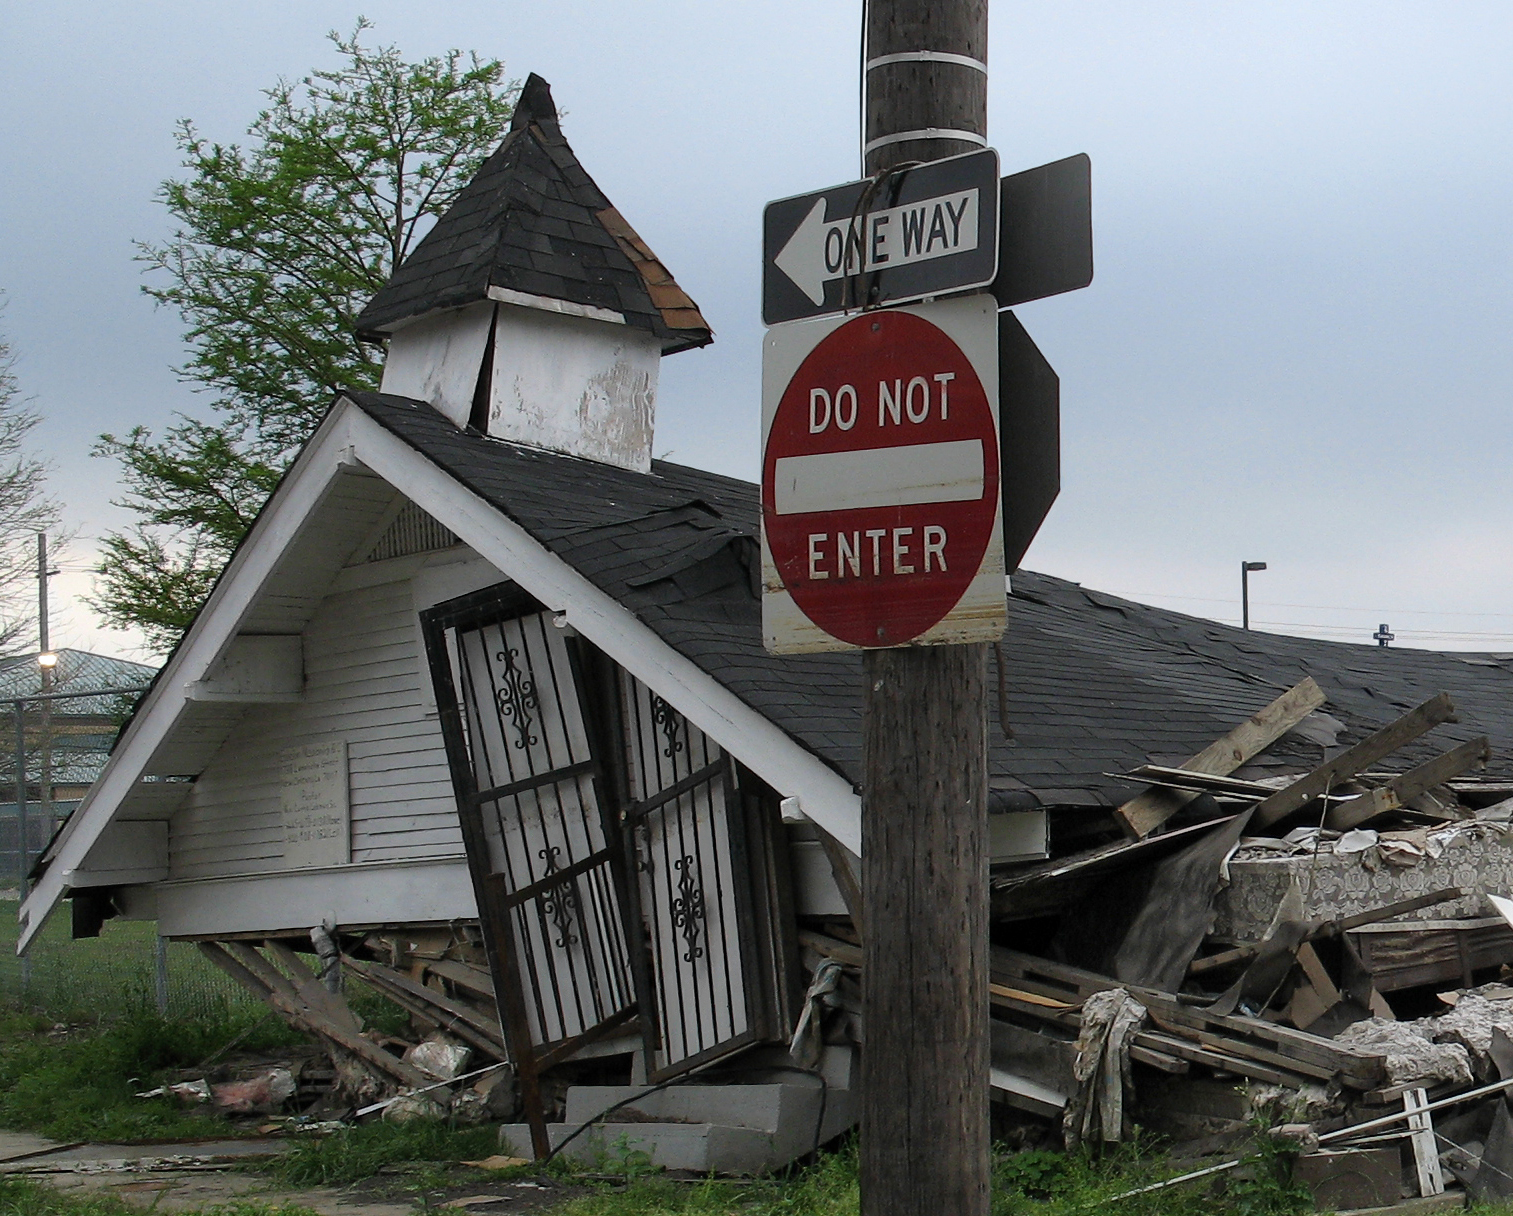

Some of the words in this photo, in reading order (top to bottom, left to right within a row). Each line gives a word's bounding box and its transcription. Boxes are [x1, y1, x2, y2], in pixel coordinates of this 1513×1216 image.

[825, 215, 890, 274] ONE
[902, 197, 969, 258] WAY
[809, 384, 858, 434] DO
[878, 372, 956, 427] NOT
[808, 525, 948, 580] ENTER
